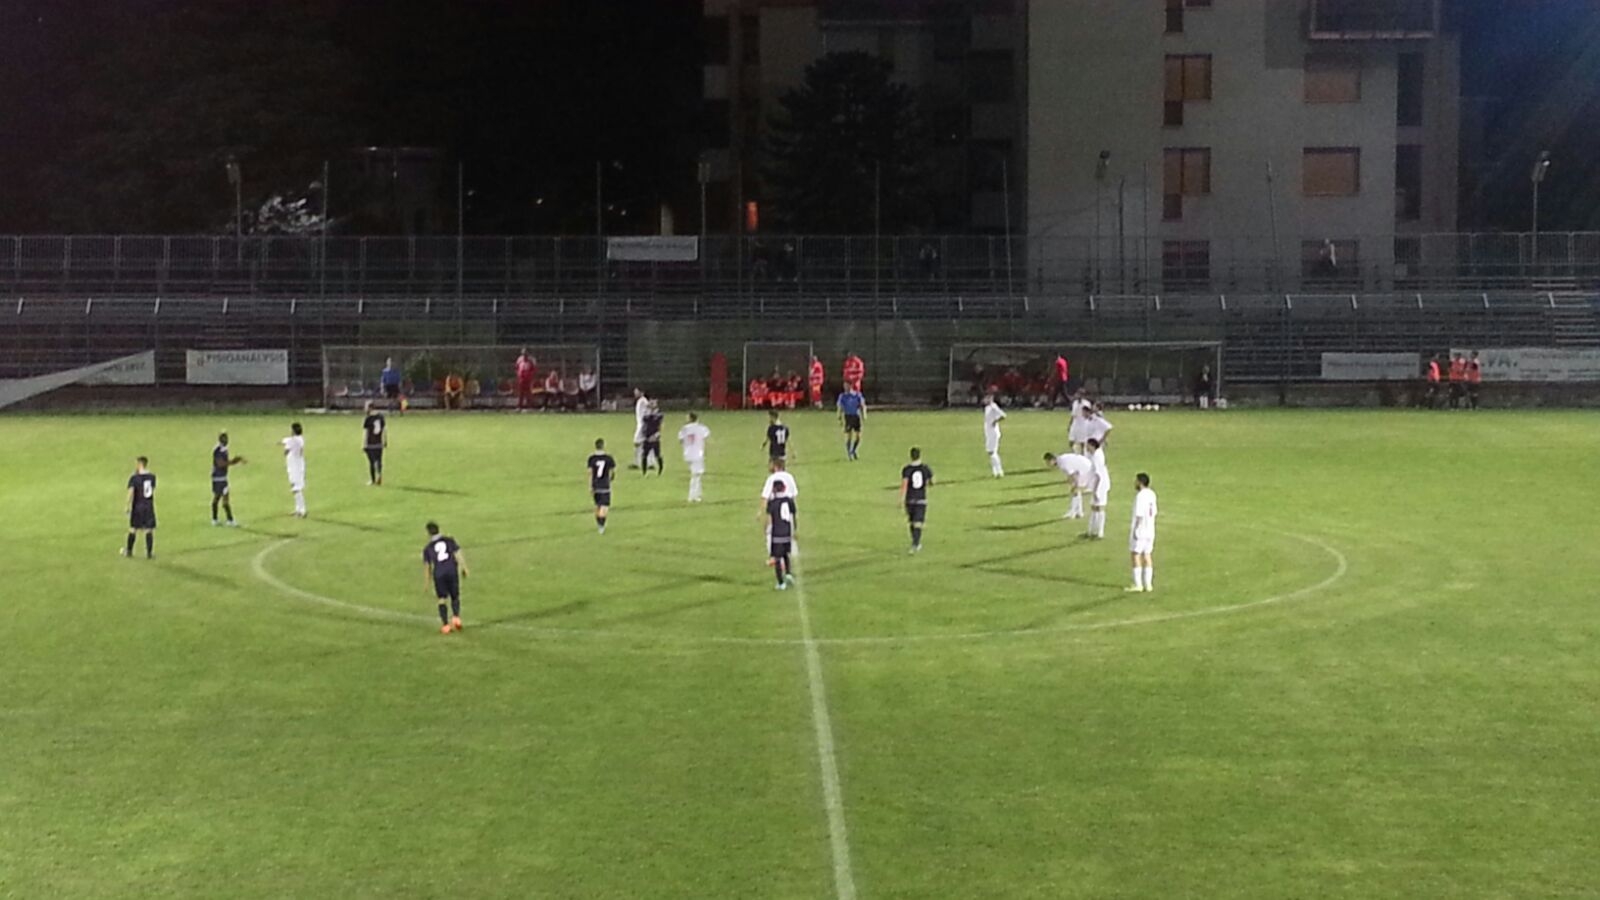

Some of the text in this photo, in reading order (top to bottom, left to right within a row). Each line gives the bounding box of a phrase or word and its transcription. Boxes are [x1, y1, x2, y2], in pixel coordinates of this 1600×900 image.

[775, 429, 786, 444] 11
[596, 460, 605, 478] 7
[780, 502, 790, 522] 4
[434, 541, 449, 562] 2
